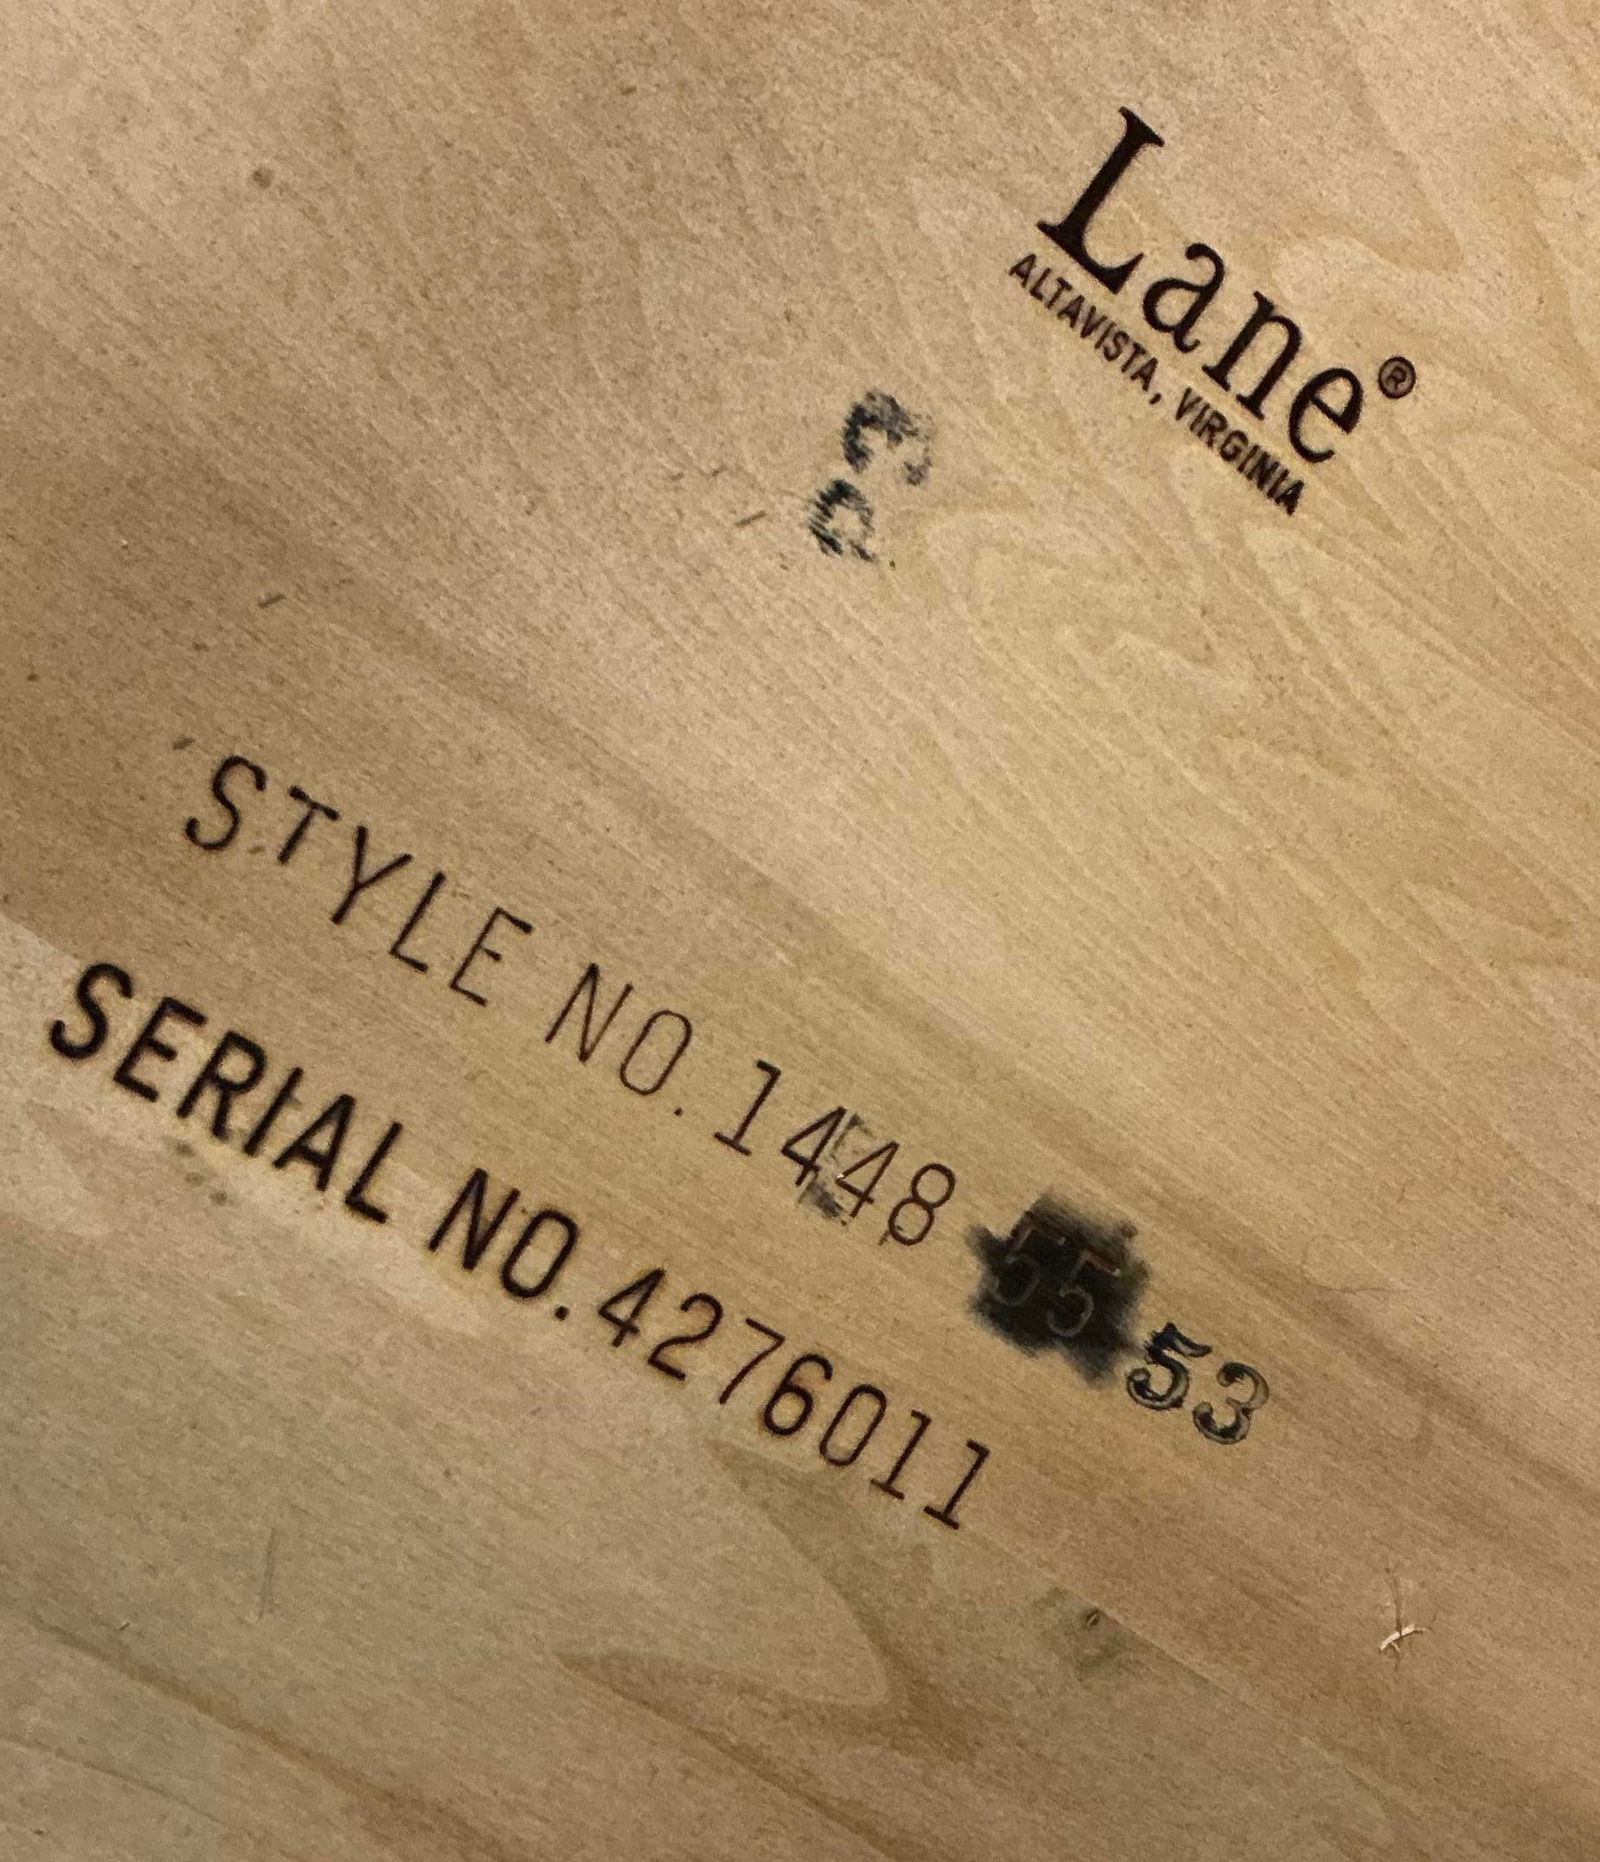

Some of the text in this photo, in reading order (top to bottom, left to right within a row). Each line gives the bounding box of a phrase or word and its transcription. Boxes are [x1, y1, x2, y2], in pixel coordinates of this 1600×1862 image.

[1174, 386, 1306, 516] VIRGINIA
[49, 962, 403, 1225] SERIAL
[184, 755, 533, 1007] STYLE
[1126, 1321, 1270, 1445] 53
